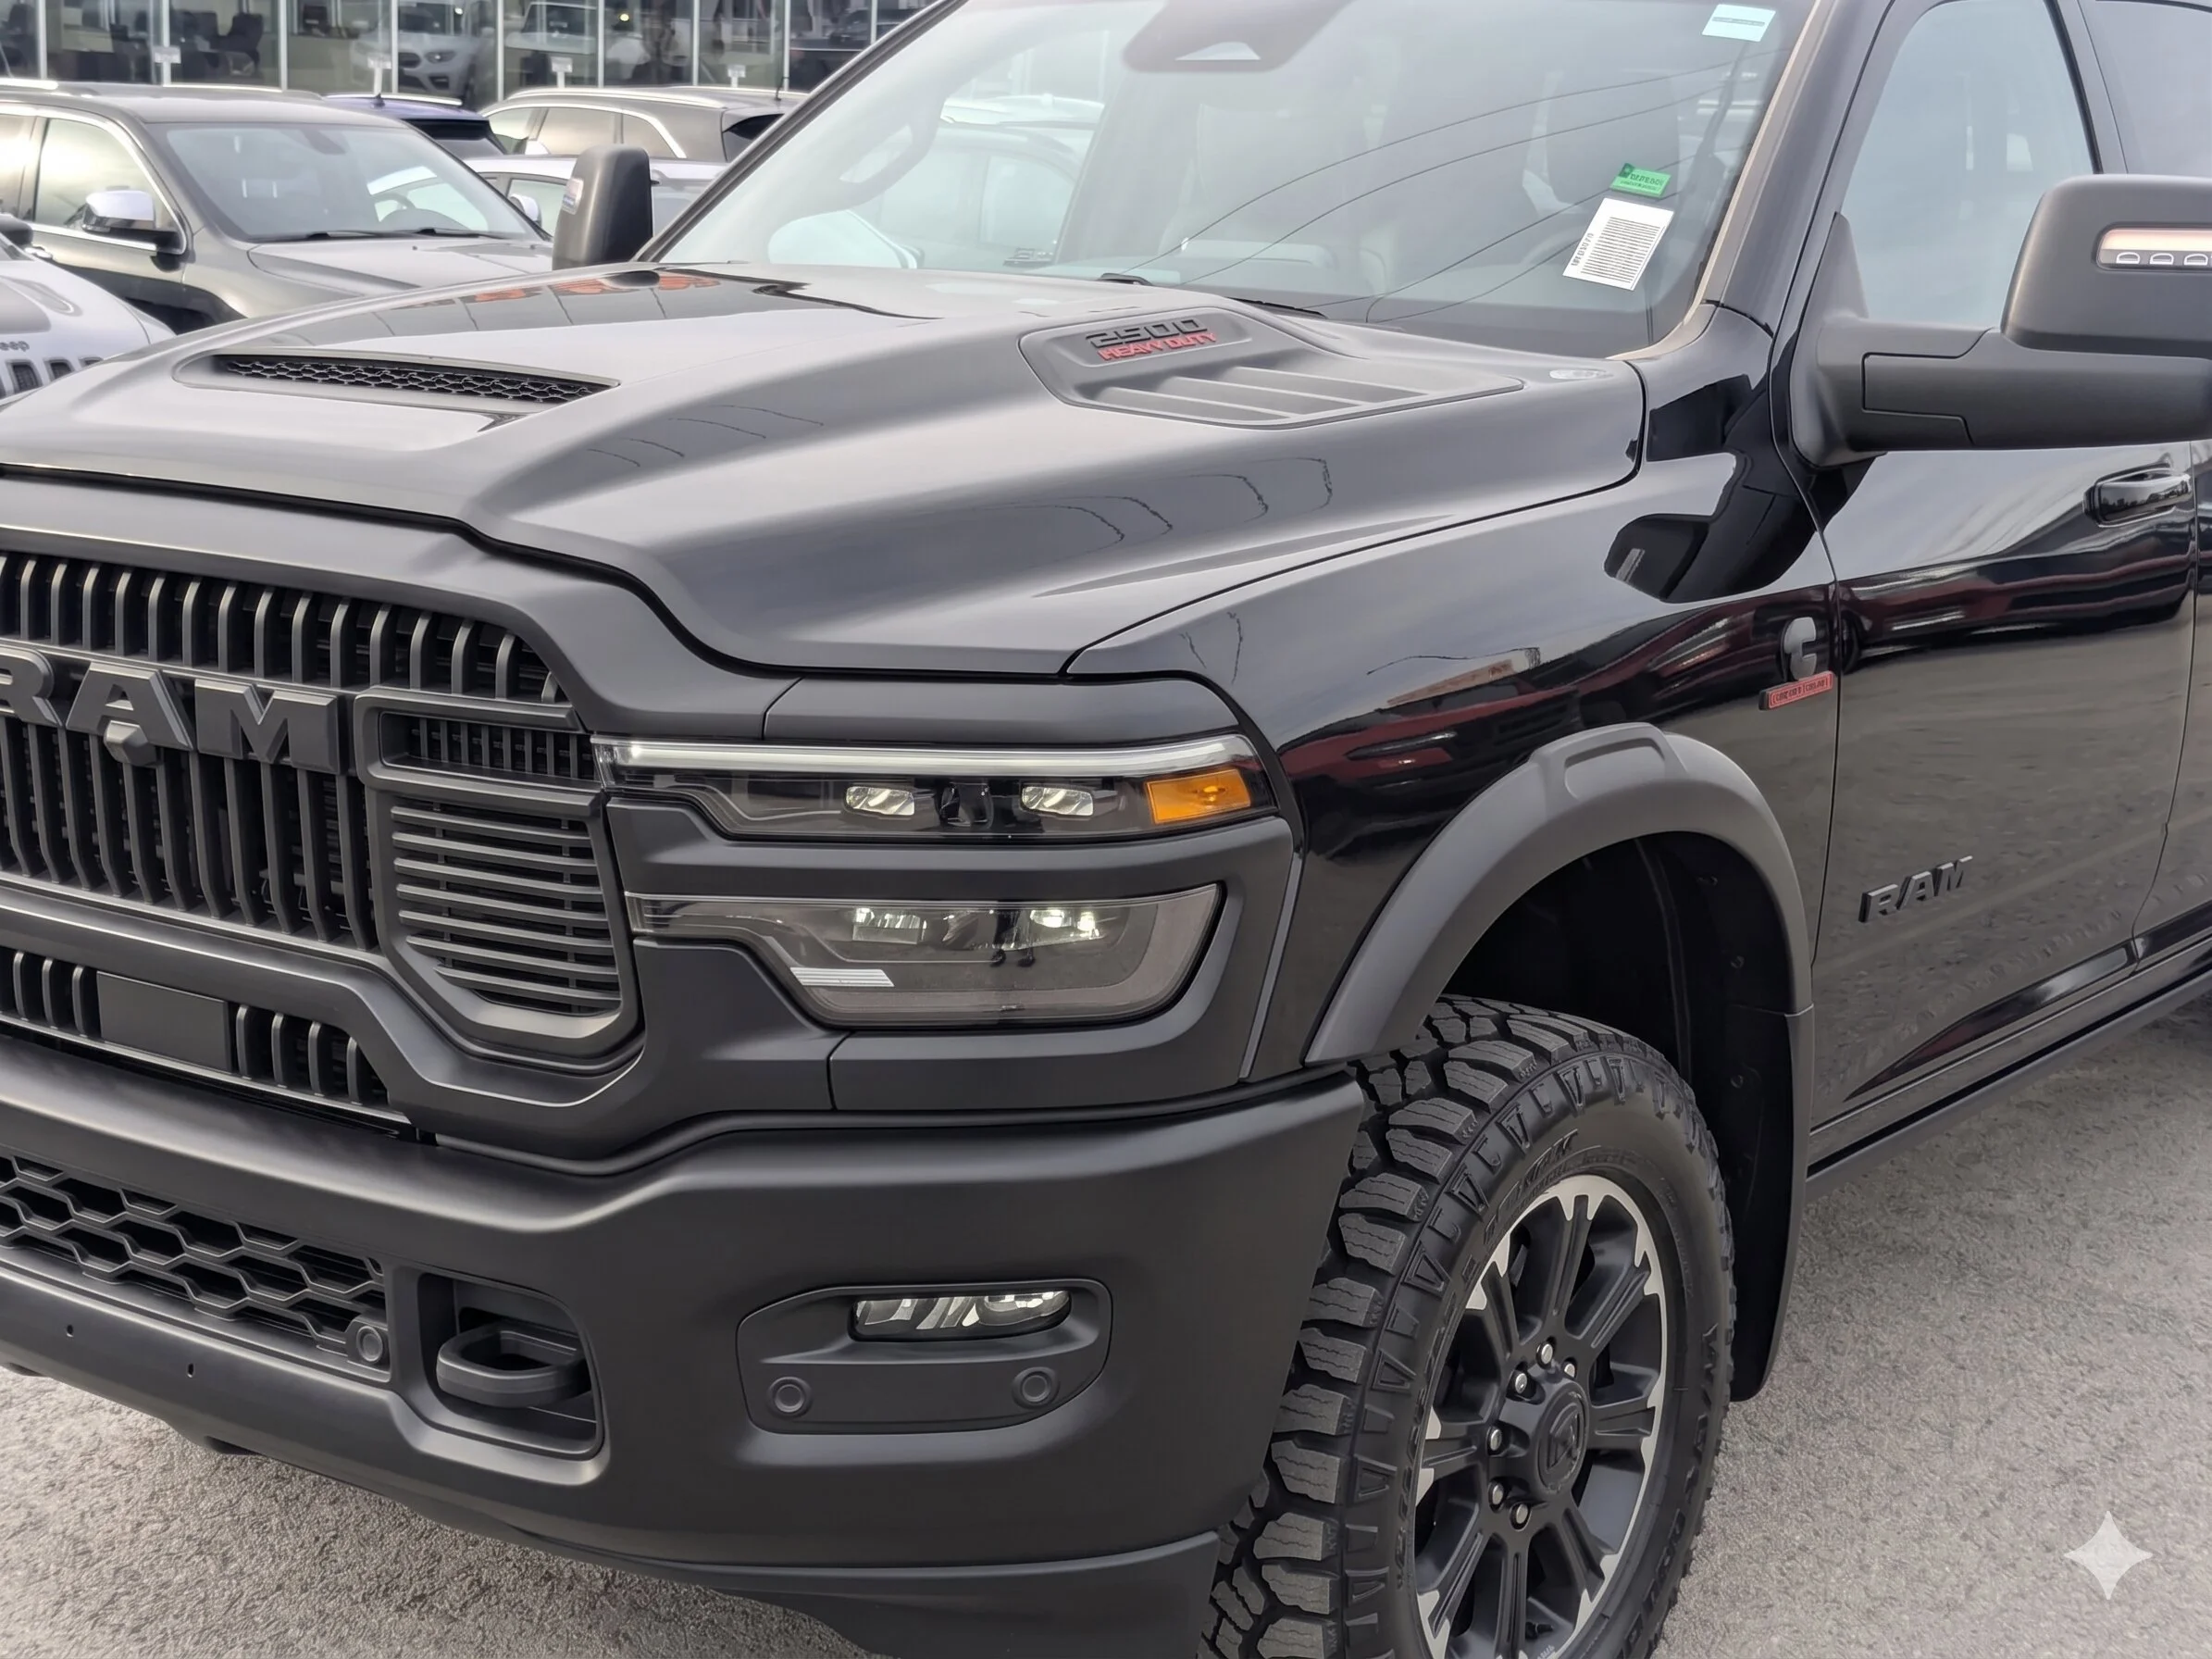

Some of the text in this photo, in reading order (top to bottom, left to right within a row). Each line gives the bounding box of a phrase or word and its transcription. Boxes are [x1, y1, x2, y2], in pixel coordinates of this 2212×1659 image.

[0, 340, 31, 353] eep
[1086, 318, 1207, 348] 2500
[1098, 332, 1216, 361] HEAVY DUTY
[0, 648, 341, 774] RAM
[1858, 854, 1973, 923] RAM
